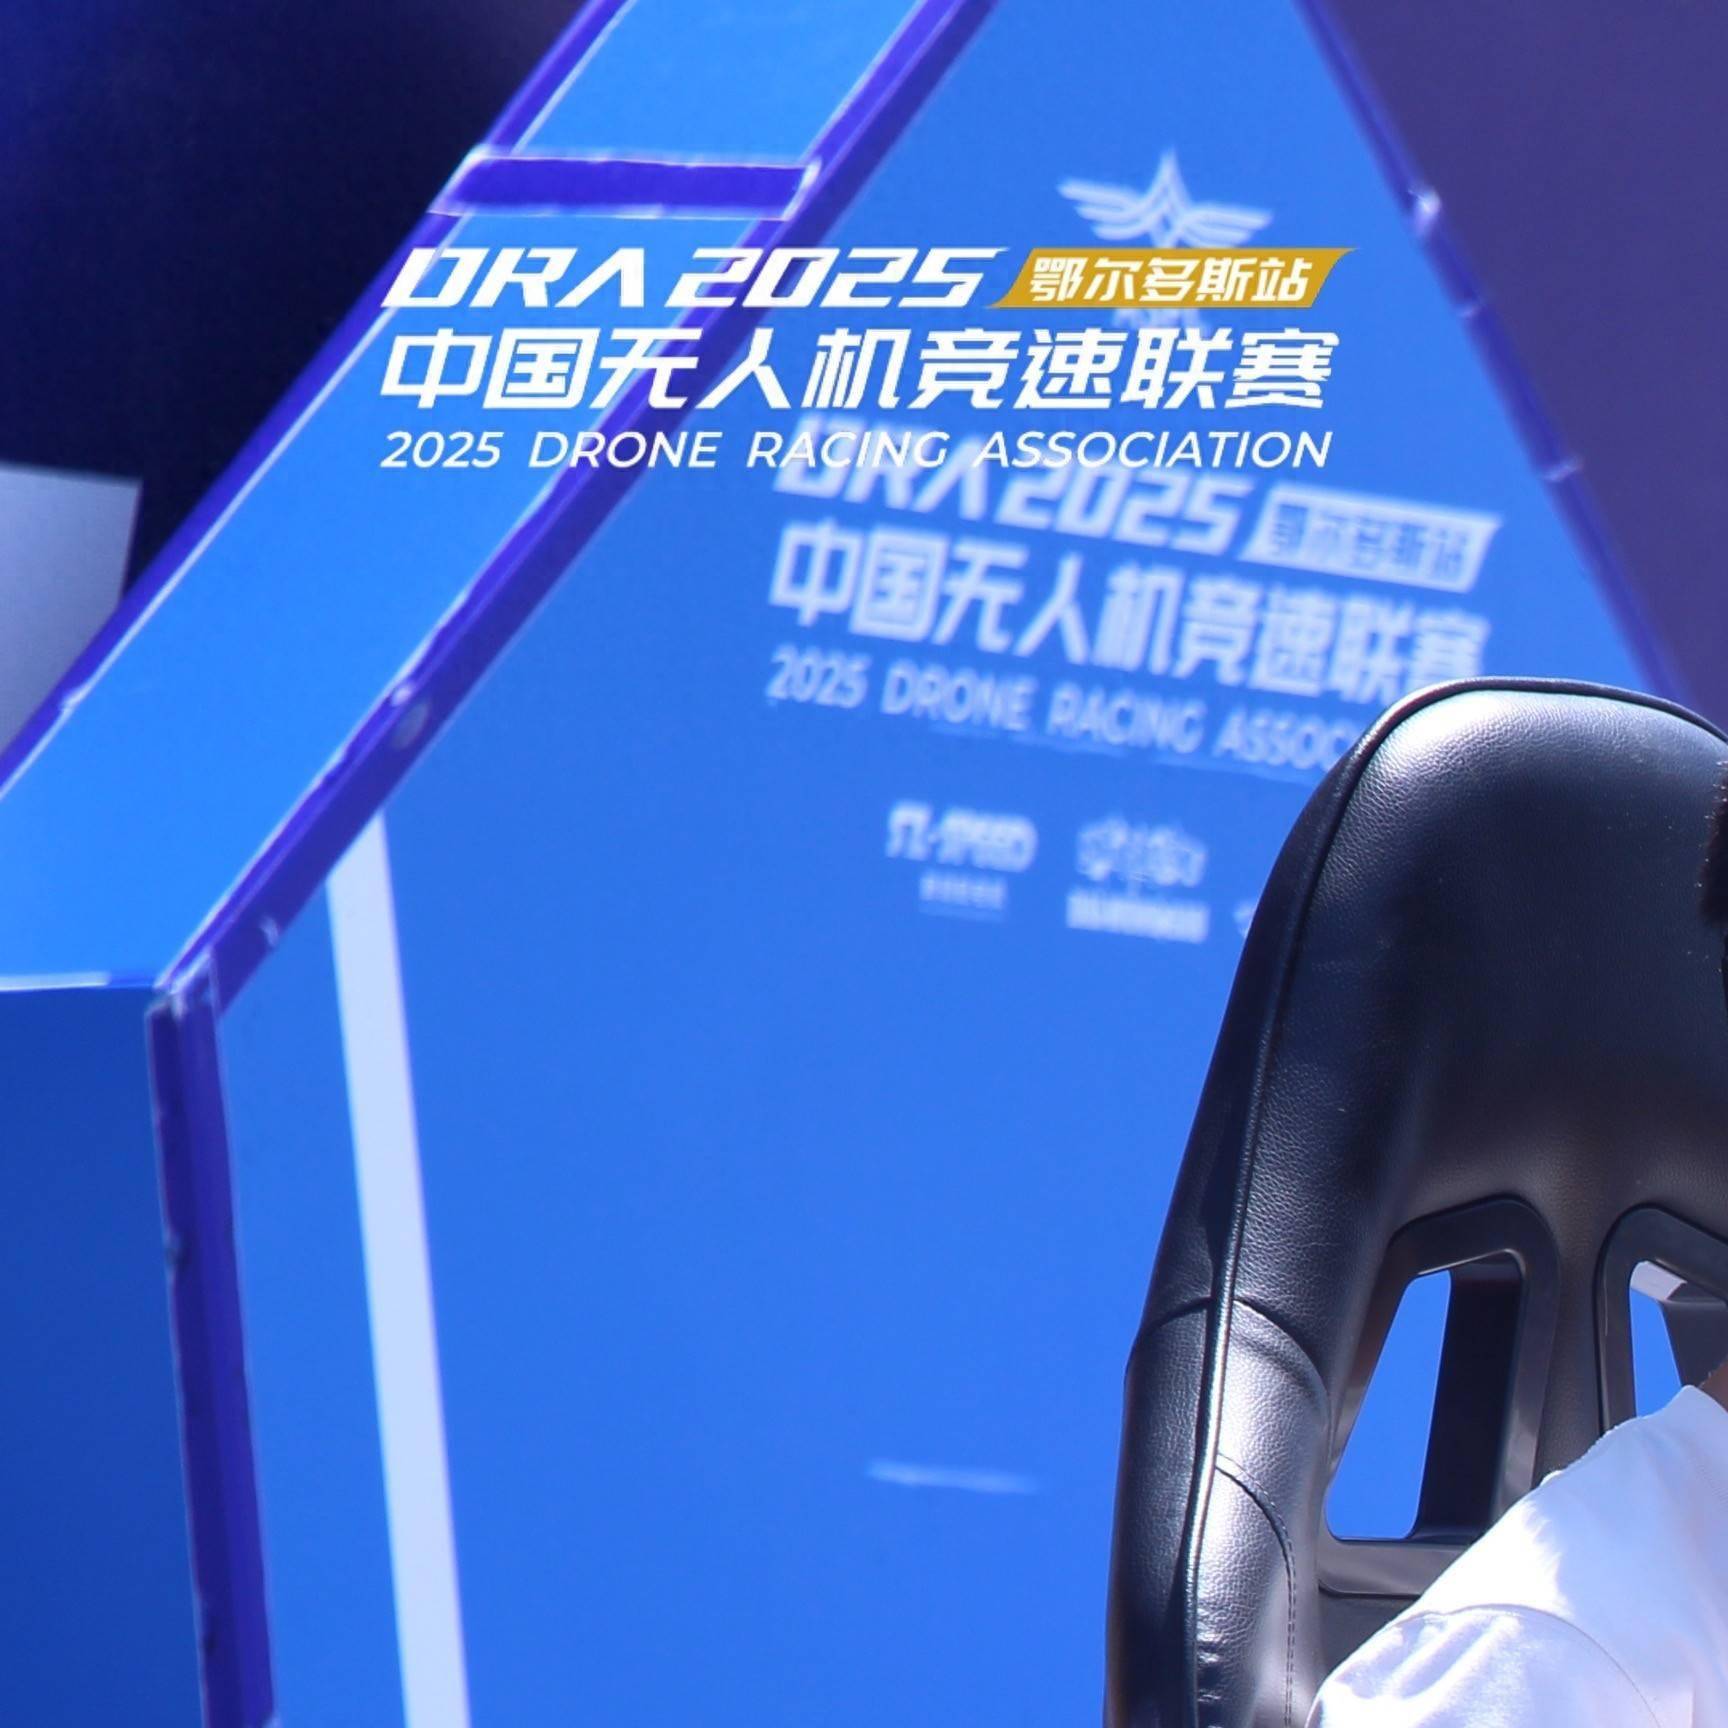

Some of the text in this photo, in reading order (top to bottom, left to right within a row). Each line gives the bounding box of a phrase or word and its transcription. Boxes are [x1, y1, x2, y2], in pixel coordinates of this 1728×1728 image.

[994, 447, 1256, 556] 2025
[765, 643, 872, 708] 2025
[878, 656, 1037, 731] DRONE
[1044, 679, 1207, 756] RACING
